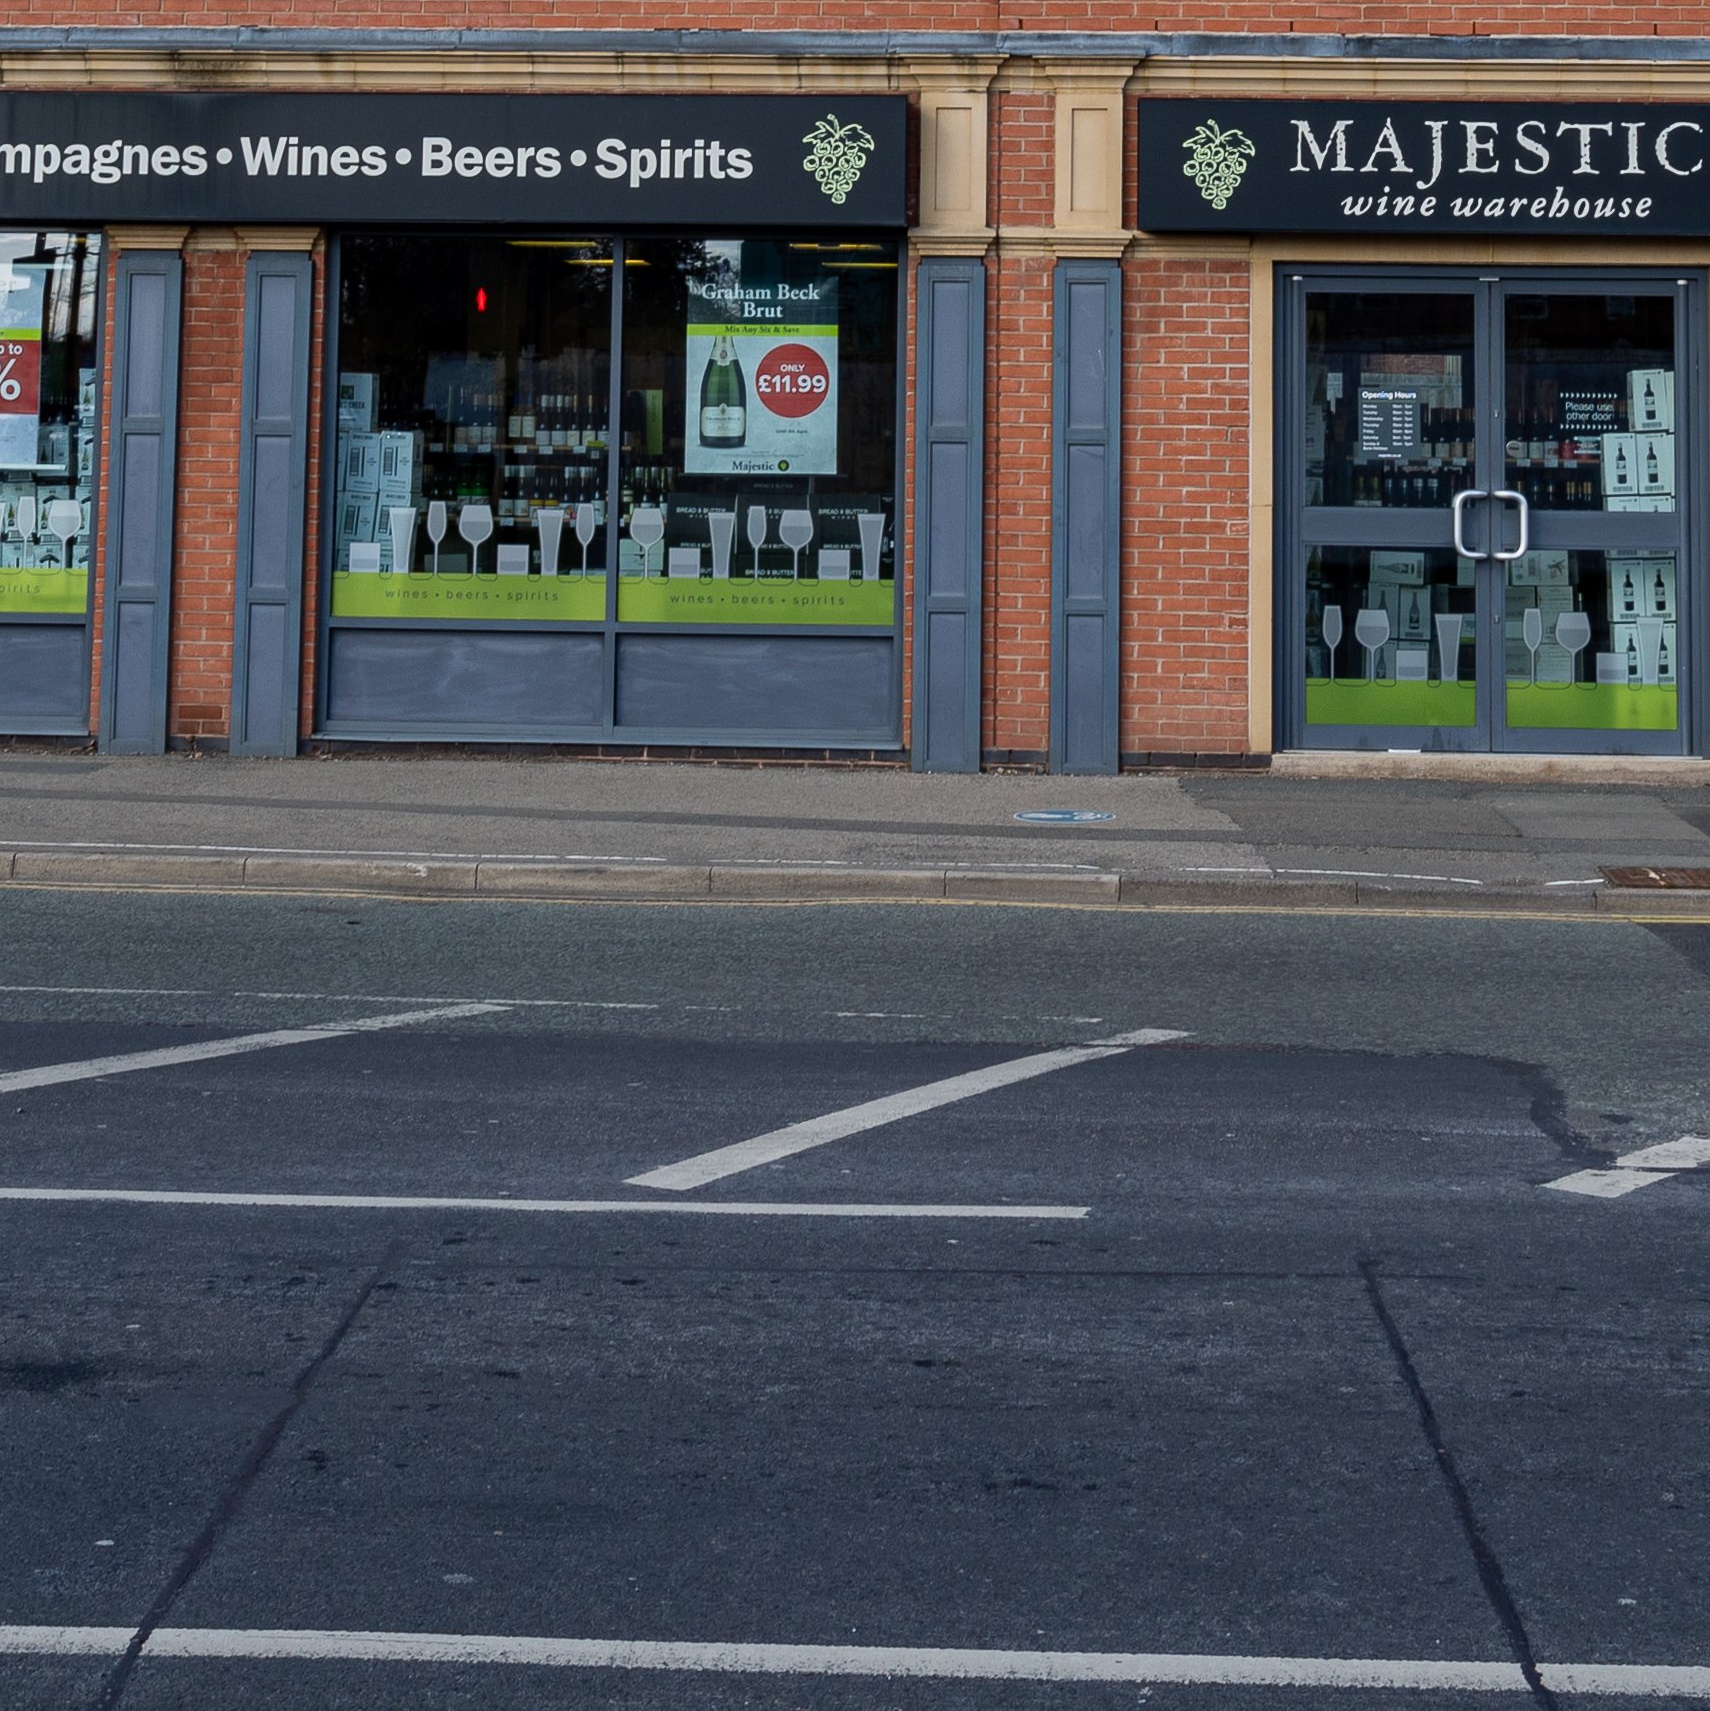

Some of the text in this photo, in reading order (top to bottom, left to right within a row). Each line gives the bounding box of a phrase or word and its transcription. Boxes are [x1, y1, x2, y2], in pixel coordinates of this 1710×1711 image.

[1289, 116, 1703, 189] MAJESTIC
[240, 136, 387, 177] Wines
[421, 137, 562, 178] Beers
[594, 138, 754, 188] Spirits
[1340, 186, 1652, 218] wine warehouse
[701, 283, 820, 300] Graham Beck
[743, 302, 783, 318] Brut
[724, 325, 739, 333] Mix
[741, 326, 757, 335] Any
[759, 325, 772, 333] Six
[783, 326, 800, 334] Save
[8, 342, 23, 355] to
[780, 363, 805, 373] ONLY
[758, 374, 827, 394] £11.99
[1361, 391, 1417, 400] Opening Hours
[1565, 402, 1595, 411] Please
[1566, 411, 1612, 421] other door
[732, 460, 774, 473] Majestic
[385, 590, 559, 602] wines beers spirits
[670, 594, 845, 606] wines beers spirits
